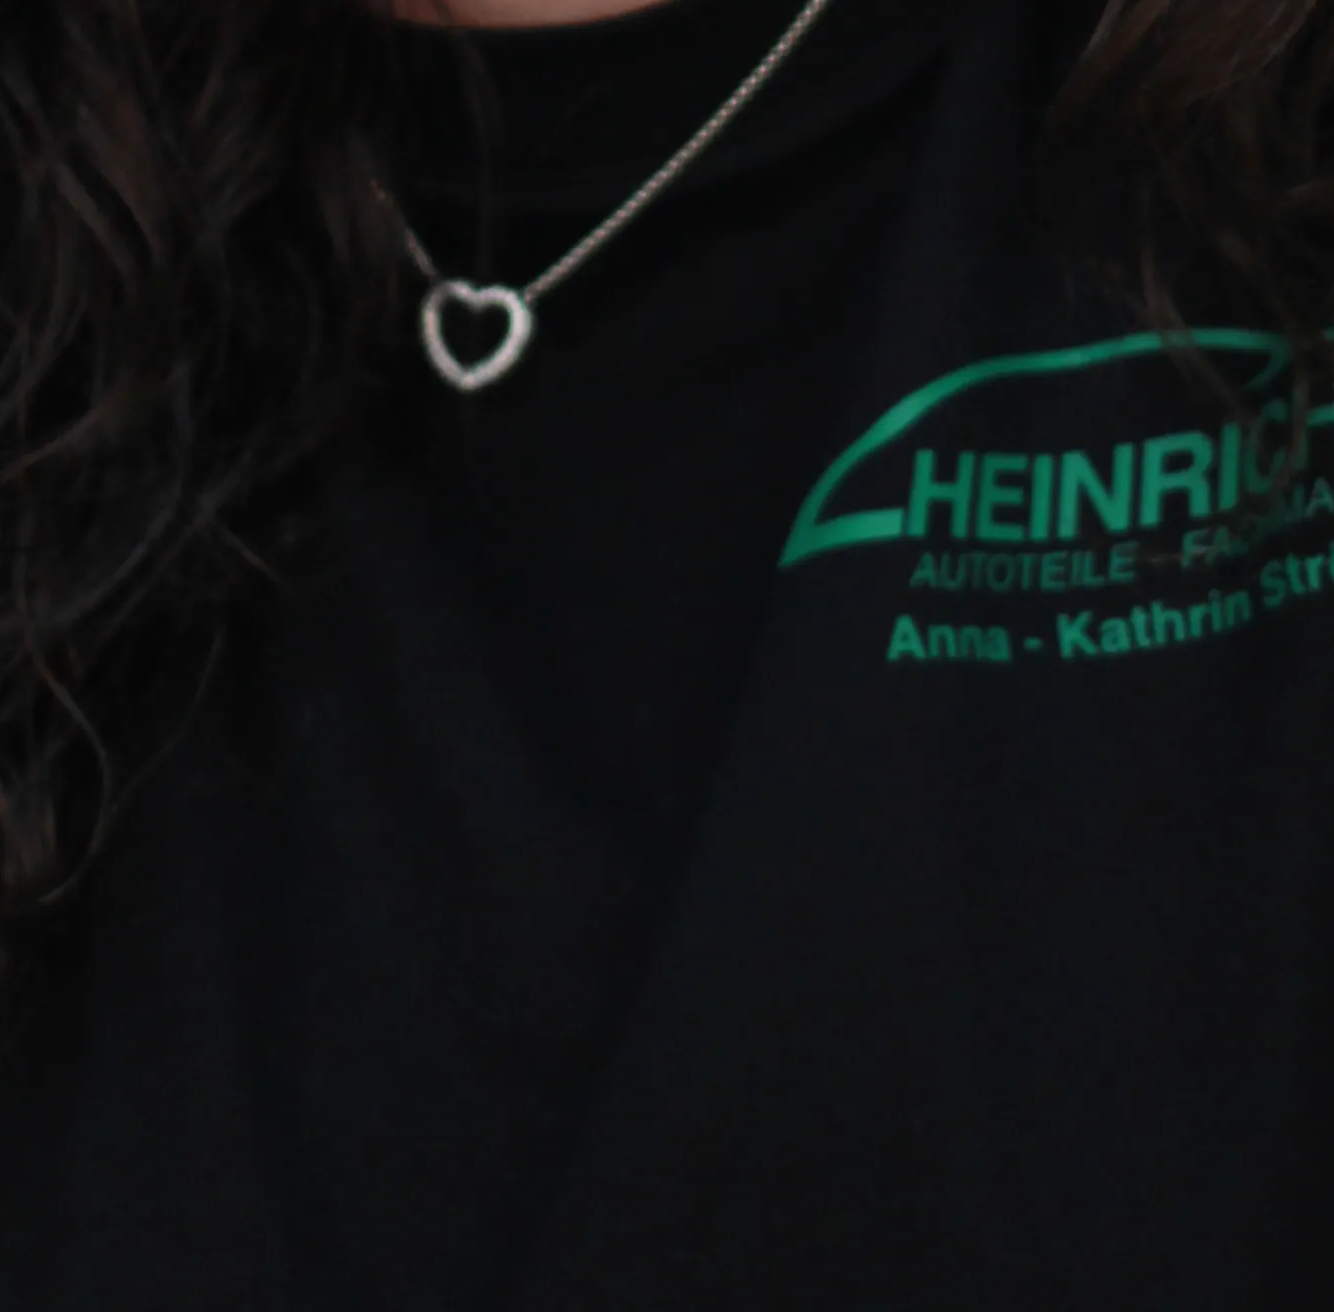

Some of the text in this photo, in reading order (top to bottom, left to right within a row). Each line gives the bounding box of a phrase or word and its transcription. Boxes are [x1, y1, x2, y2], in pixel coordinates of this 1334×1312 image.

[909, 540, 1138, 593] AUTOTEILE
[885, 614, 1013, 663] Anna
[1056, 587, 1253, 662] Kathrin
